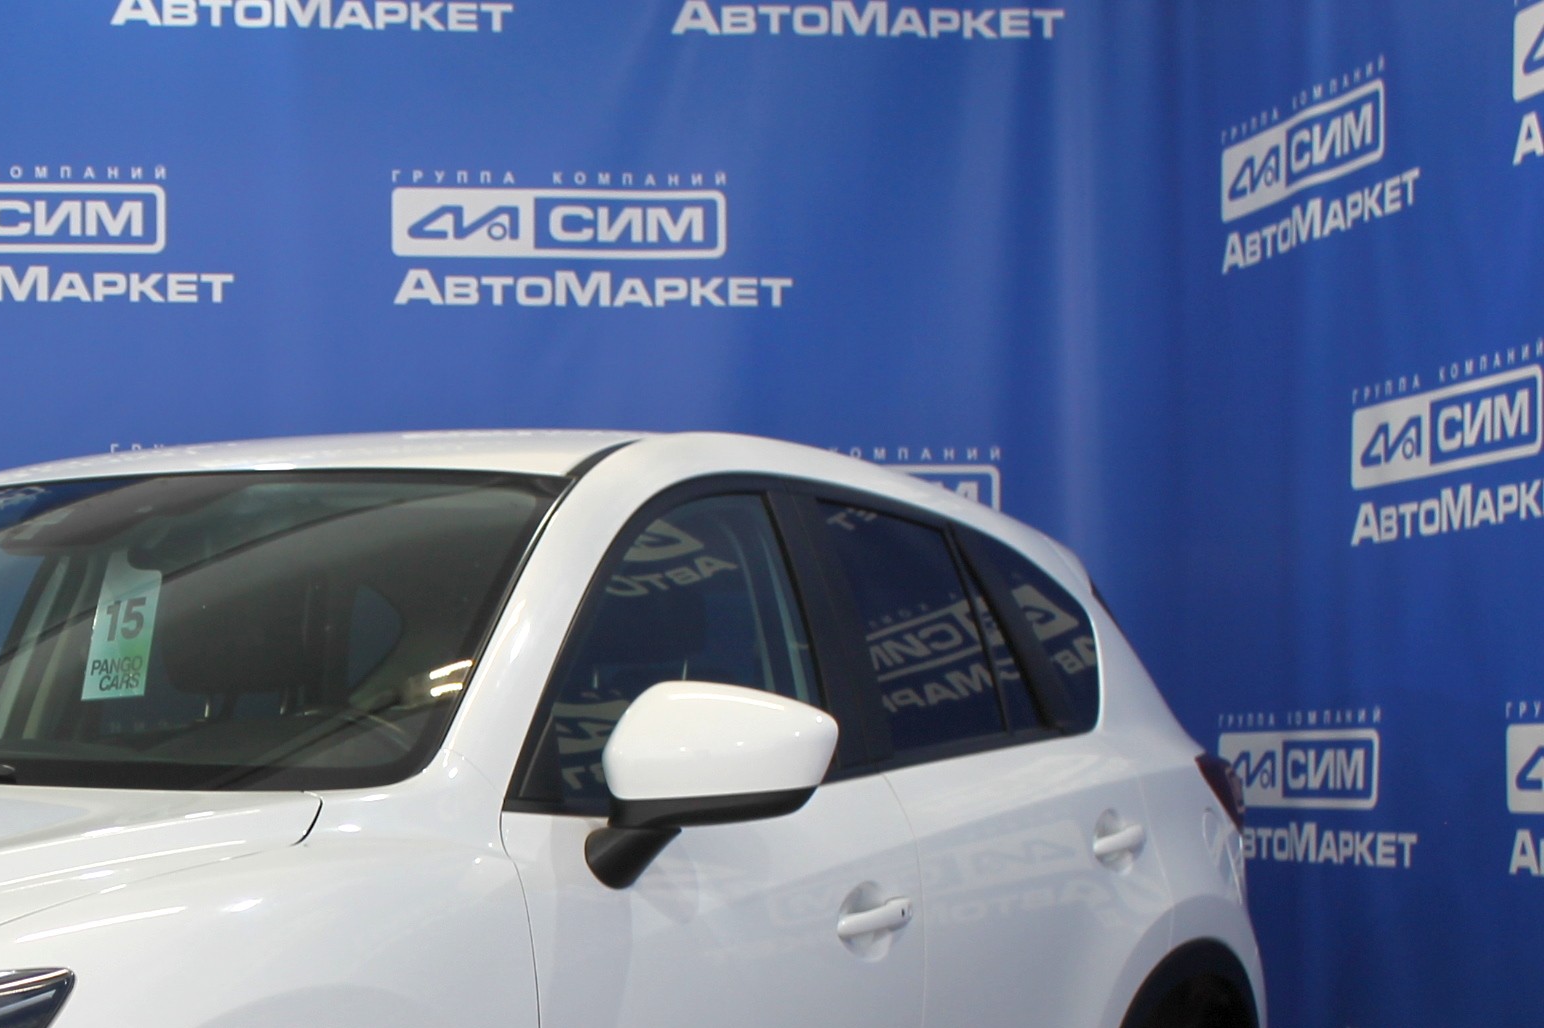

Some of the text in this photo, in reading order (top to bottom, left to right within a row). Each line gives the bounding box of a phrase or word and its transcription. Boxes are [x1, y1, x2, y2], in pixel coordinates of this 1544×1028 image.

[1291, 101, 1373, 174] СИМ
[391, 169, 727, 187] ГРУППА КОМПАНИЙ
[549, 205, 705, 243] СИМ
[1352, 373, 1420, 404] ГРУППА
[1437, 388, 1530, 453] СИМ
[106, 596, 147, 642] 15
[90, 656, 144, 676] PANGO
[98, 672, 141, 692] CARS
[1286, 747, 1366, 790] СИМ
[1243, 821, 1418, 868] втоМаркет
